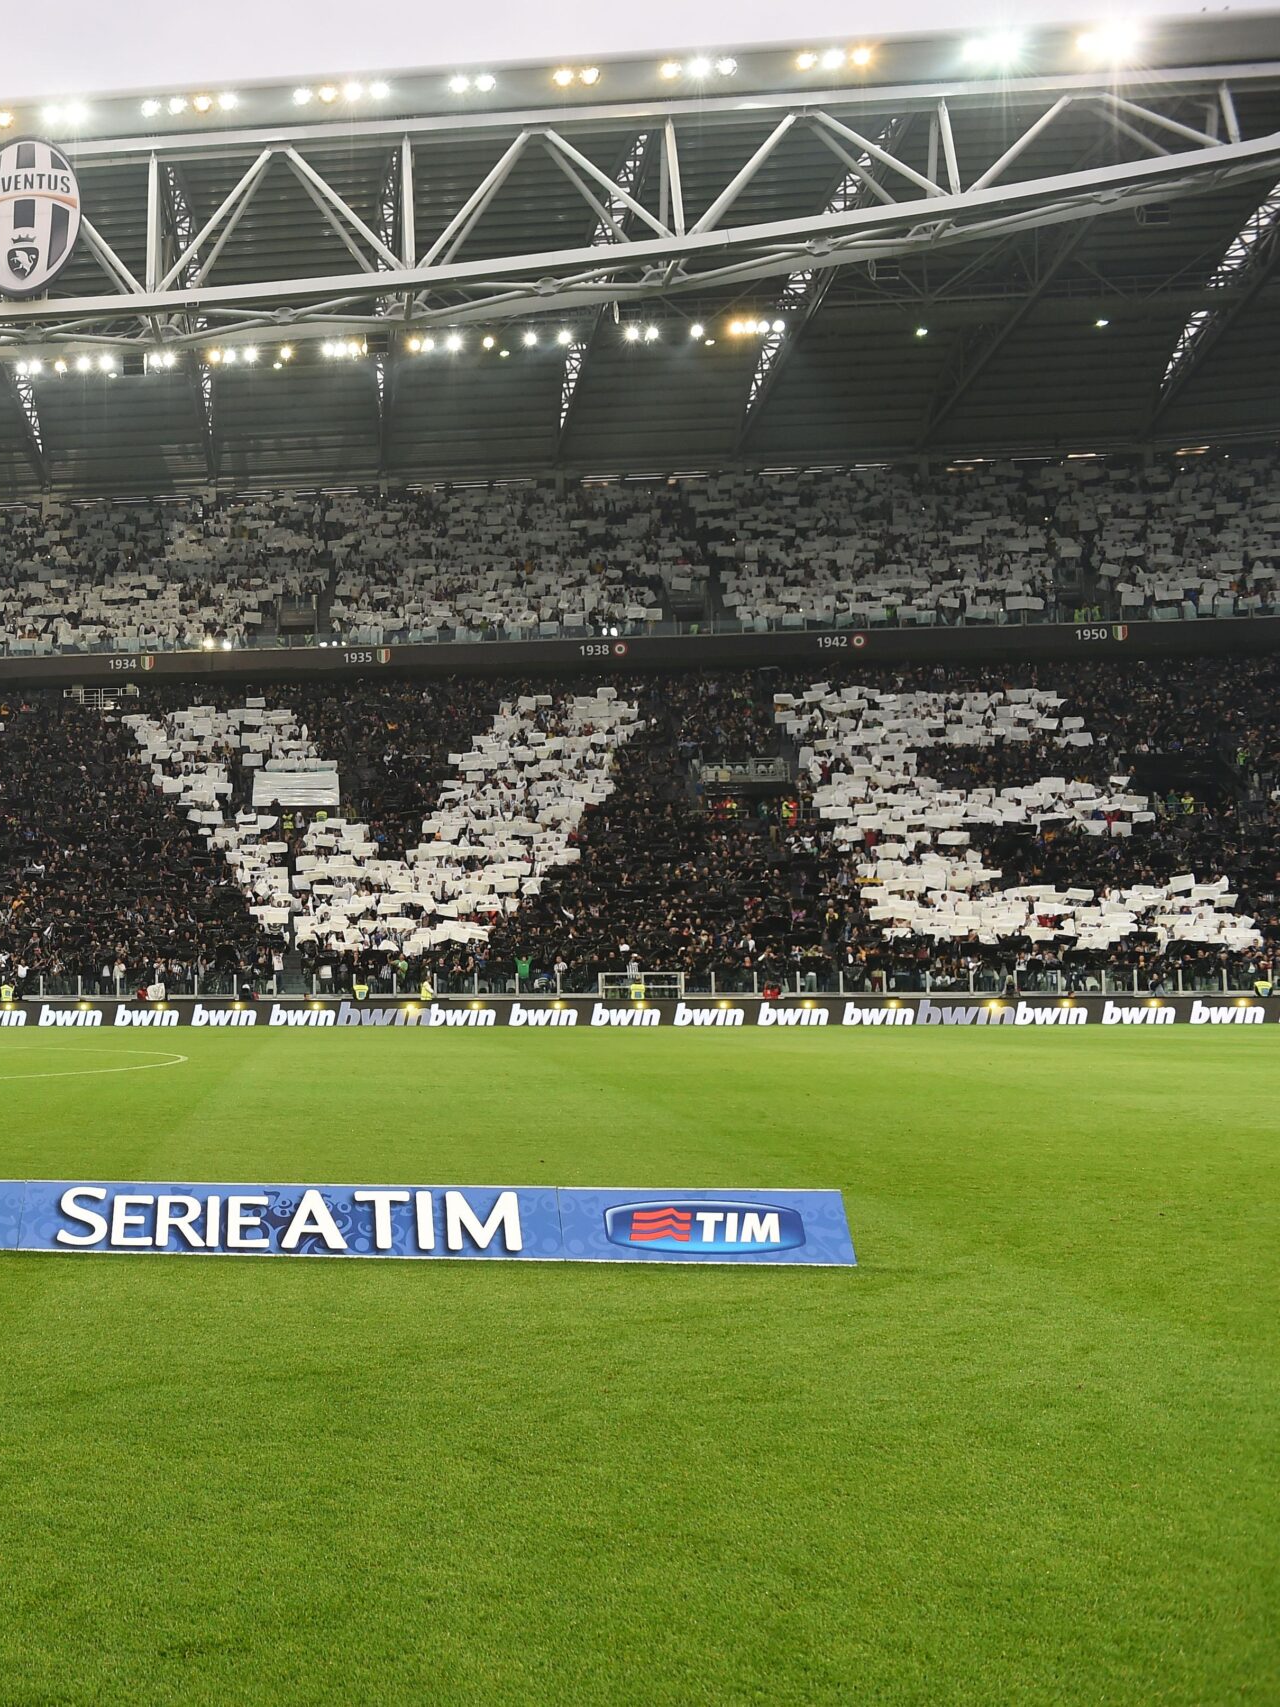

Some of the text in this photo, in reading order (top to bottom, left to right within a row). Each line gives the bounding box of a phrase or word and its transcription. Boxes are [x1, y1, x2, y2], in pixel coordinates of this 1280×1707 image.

[1075, 629, 1108, 641] 1950
[817, 636, 848, 648] 1942
[579, 644, 610, 656] 1938
[343, 652, 372, 663] 1935
[108, 659, 137, 670] 1934
[39, 1003, 102, 1025] bwin
[115, 1003, 179, 1025] bwin
[192, 1003, 256, 1025] bwin
[270, 1003, 336, 1025] bwin
[336, 1001, 432, 1025] bwin
[430, 1002, 496, 1025] bwin
[509, 1002, 578, 1025] bwin
[591, 1002, 660, 1025] bwin
[674, 1002, 744, 1025] bwin
[758, 1002, 829, 1025] bwin
[843, 1001, 915, 1025] bwin
[915, 1000, 1016, 1025] bwin
[1014, 1001, 1088, 1025] bwin
[1102, 1001, 1175, 1024] bwin
[1189, 1000, 1265, 1024] bwin
[56, 1186, 523, 1251] SERIE A TIM
[696, 1212, 781, 1243] TIM
